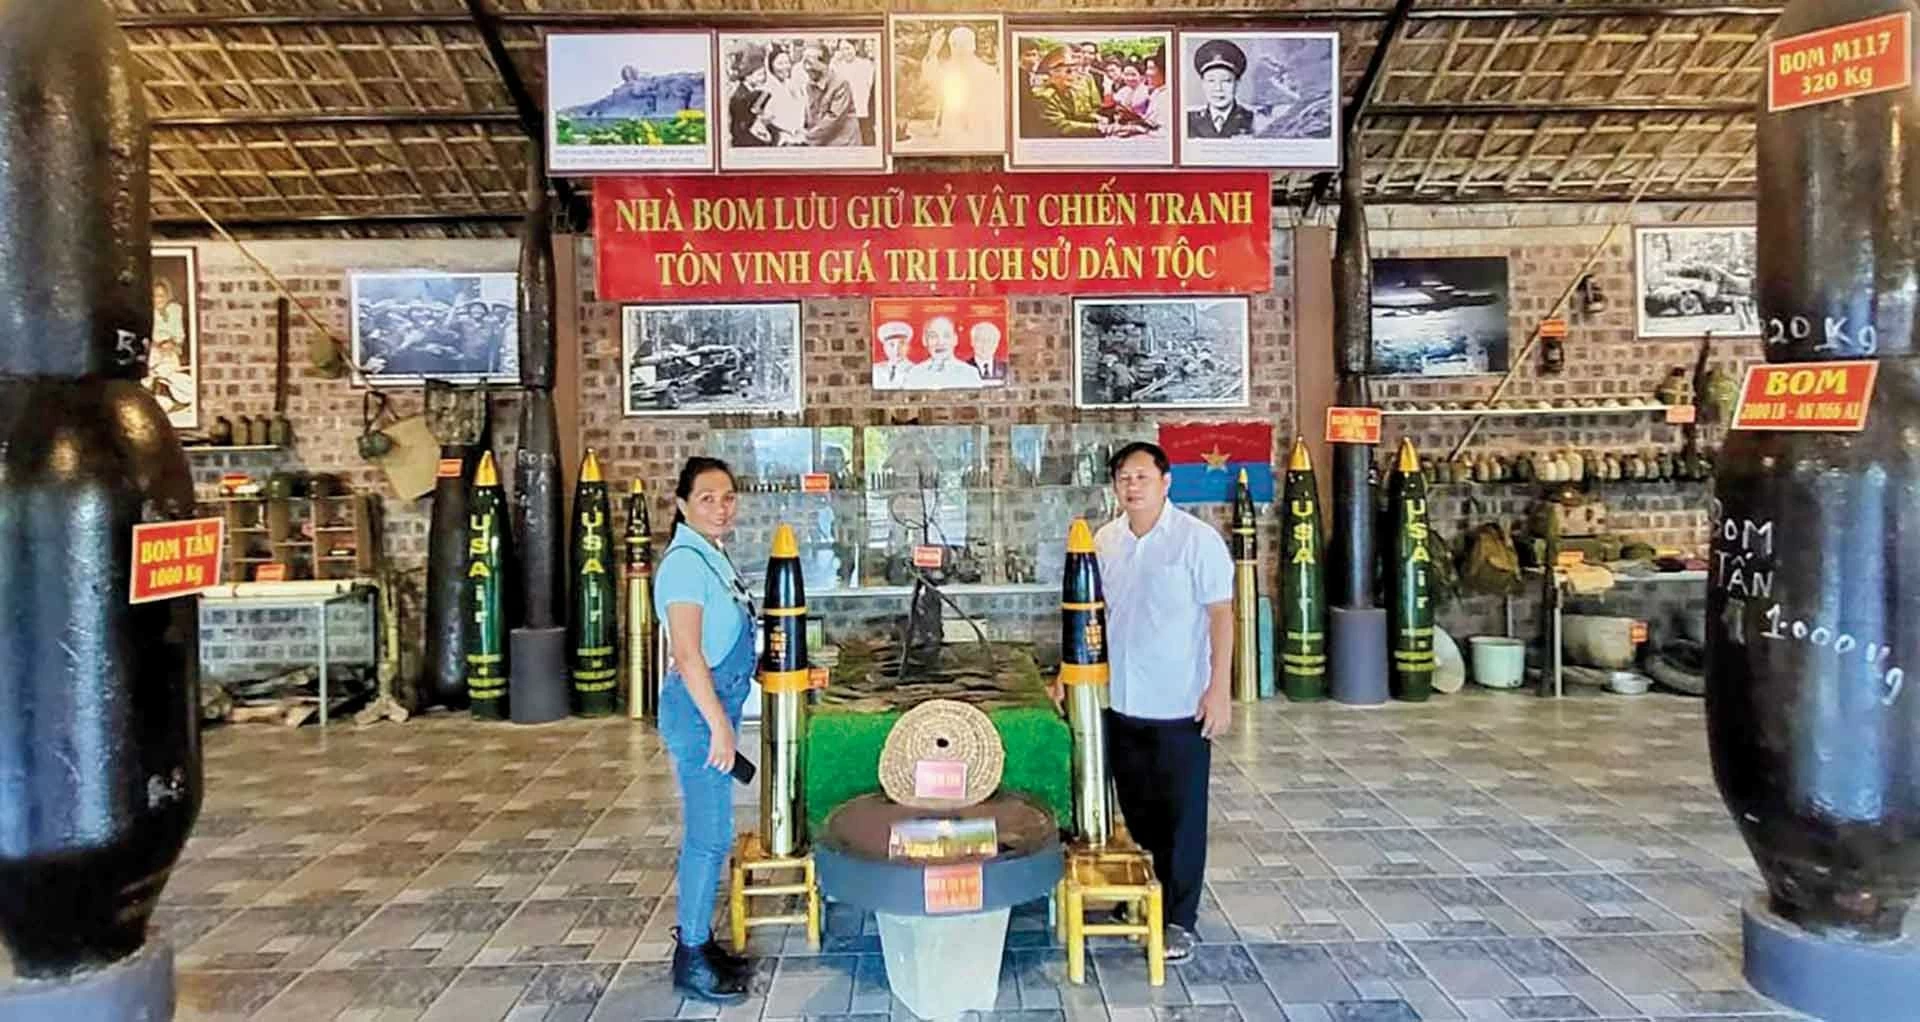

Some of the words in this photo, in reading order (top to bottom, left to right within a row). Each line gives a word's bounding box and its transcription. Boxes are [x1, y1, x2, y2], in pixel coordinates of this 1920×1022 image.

[1779, 47, 1826, 75] BOM
[1832, 31, 1892, 64] M117
[1802, 71, 1838, 95] 320
[1844, 65, 1873, 88] Kg
[615, 187, 683, 233] NHÀ
[693, 197, 766, 231] BOM
[774, 191, 838, 231] LƯU
[847, 187, 905, 230] GIỮ
[912, 183, 958, 229] KỶ
[966, 184, 1030, 237] VẬT
[1038, 177, 1137, 228] CHIẾN
[1145, 191, 1252, 226] TRANH
[655, 242, 722, 287] TÔN
[730, 249, 811, 285] VINH
[819, 240, 877, 285] GIÁ
[884, 247, 938, 291] TRỊ
[946, 246, 1025, 293] LỊCH
[1031, 236, 1072, 281] SỬ
[1078, 236, 1144, 280] DÂN
[1151, 236, 1217, 287] TỘC
[1760, 315, 1811, 344] 20
[1814, 316, 1877, 355] Kg
[1765, 368, 1848, 396] BOM
[141, 538, 181, 564] BOM
[149, 565, 183, 589] 1000
